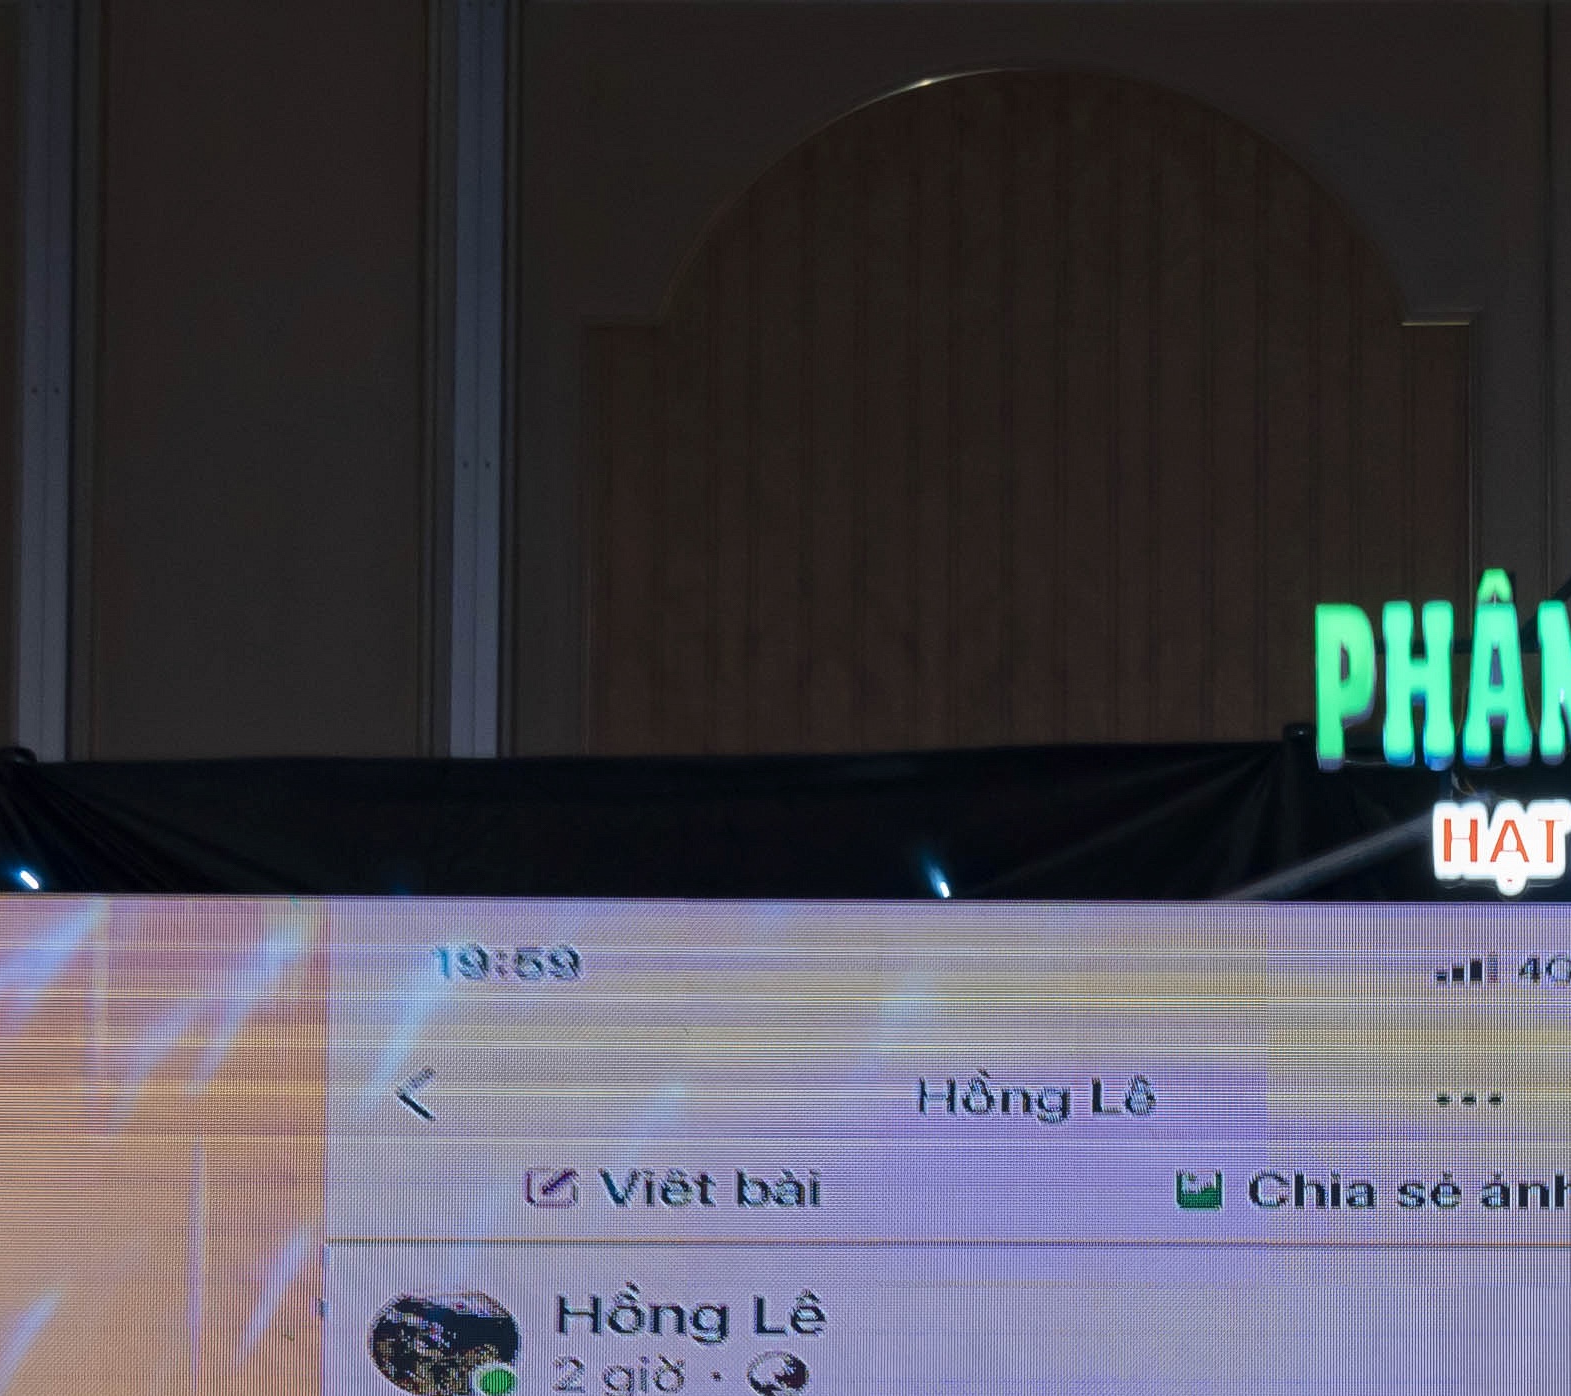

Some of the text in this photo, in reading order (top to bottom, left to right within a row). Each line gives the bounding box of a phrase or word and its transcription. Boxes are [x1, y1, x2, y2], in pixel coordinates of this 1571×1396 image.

[1432, 798, 1567, 897] HẠT
[432, 943, 582, 981] 19:59
[598, 1168, 823, 1208] Viết bài
[1249, 1170, 1375, 1210] Chia
[555, 1281, 828, 1344] Hồng Lê
[552, 1358, 586, 1394] 2
